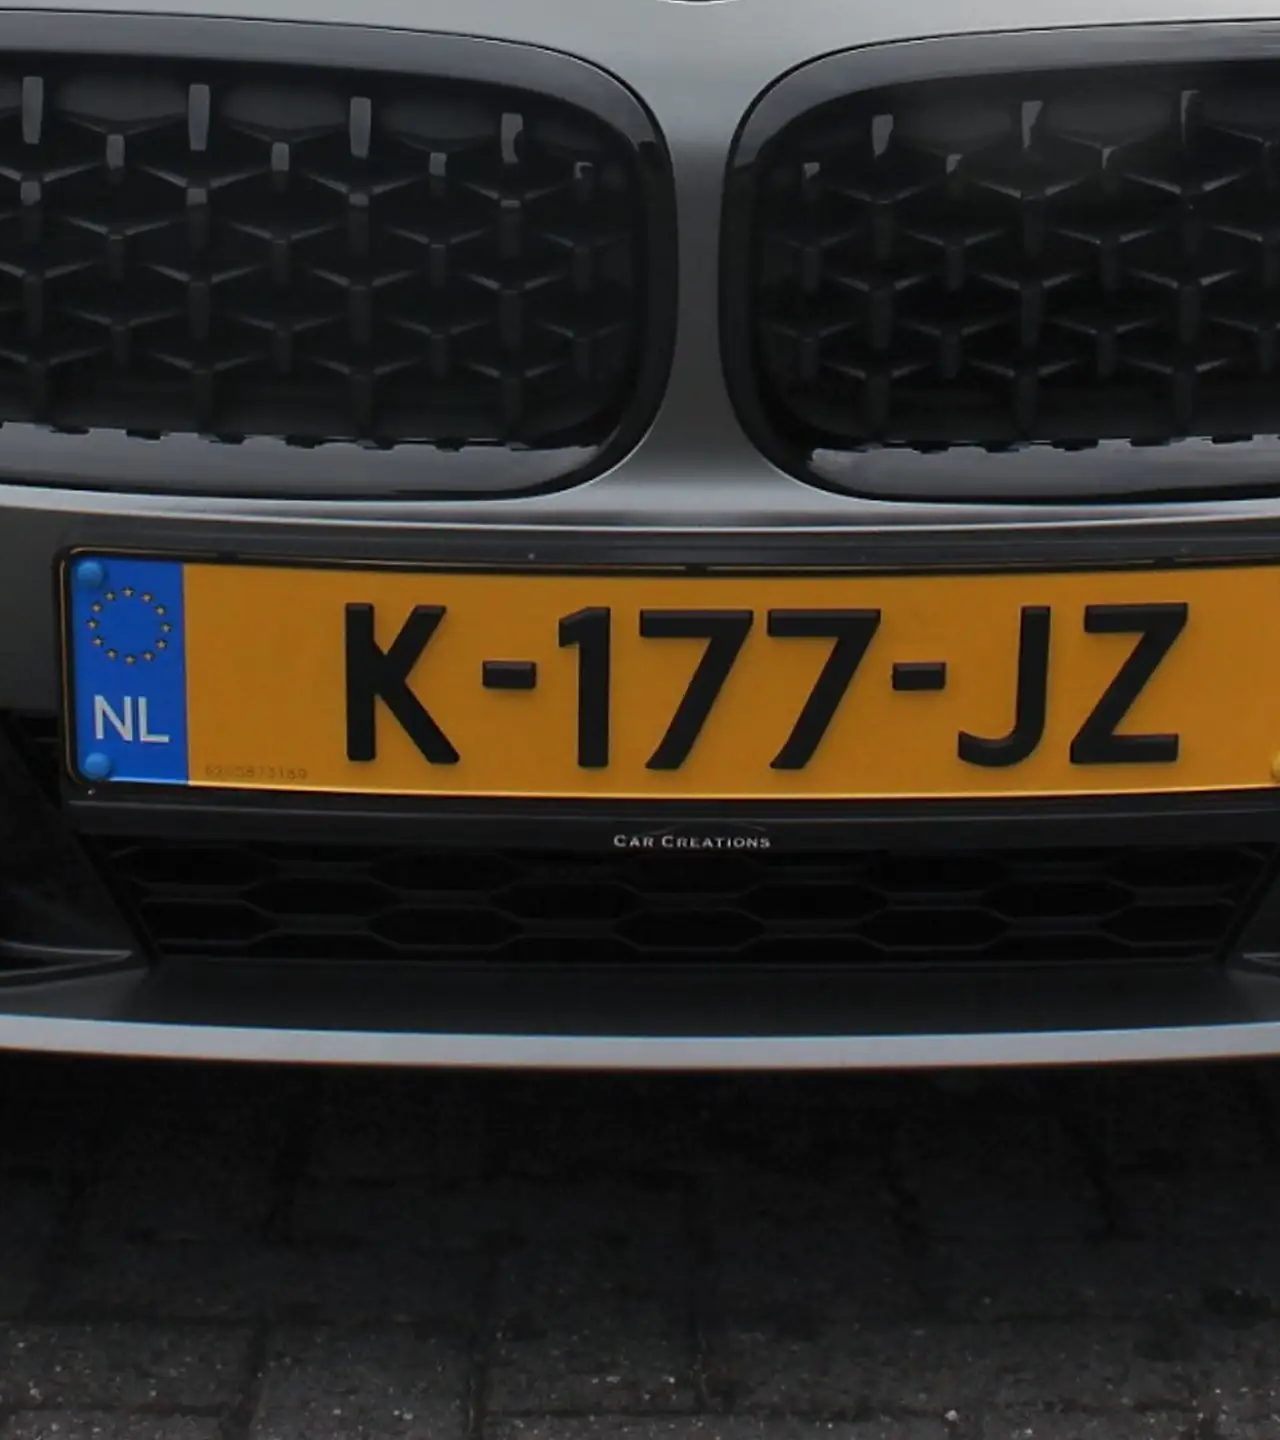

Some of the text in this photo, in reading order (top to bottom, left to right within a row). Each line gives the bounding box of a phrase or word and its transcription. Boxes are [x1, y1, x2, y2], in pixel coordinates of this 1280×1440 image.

[344, 601, 1189, 772] K-177-JZ
[93, 694, 170, 744] NL
[613, 834, 771, 849] CAR CREATIONS
